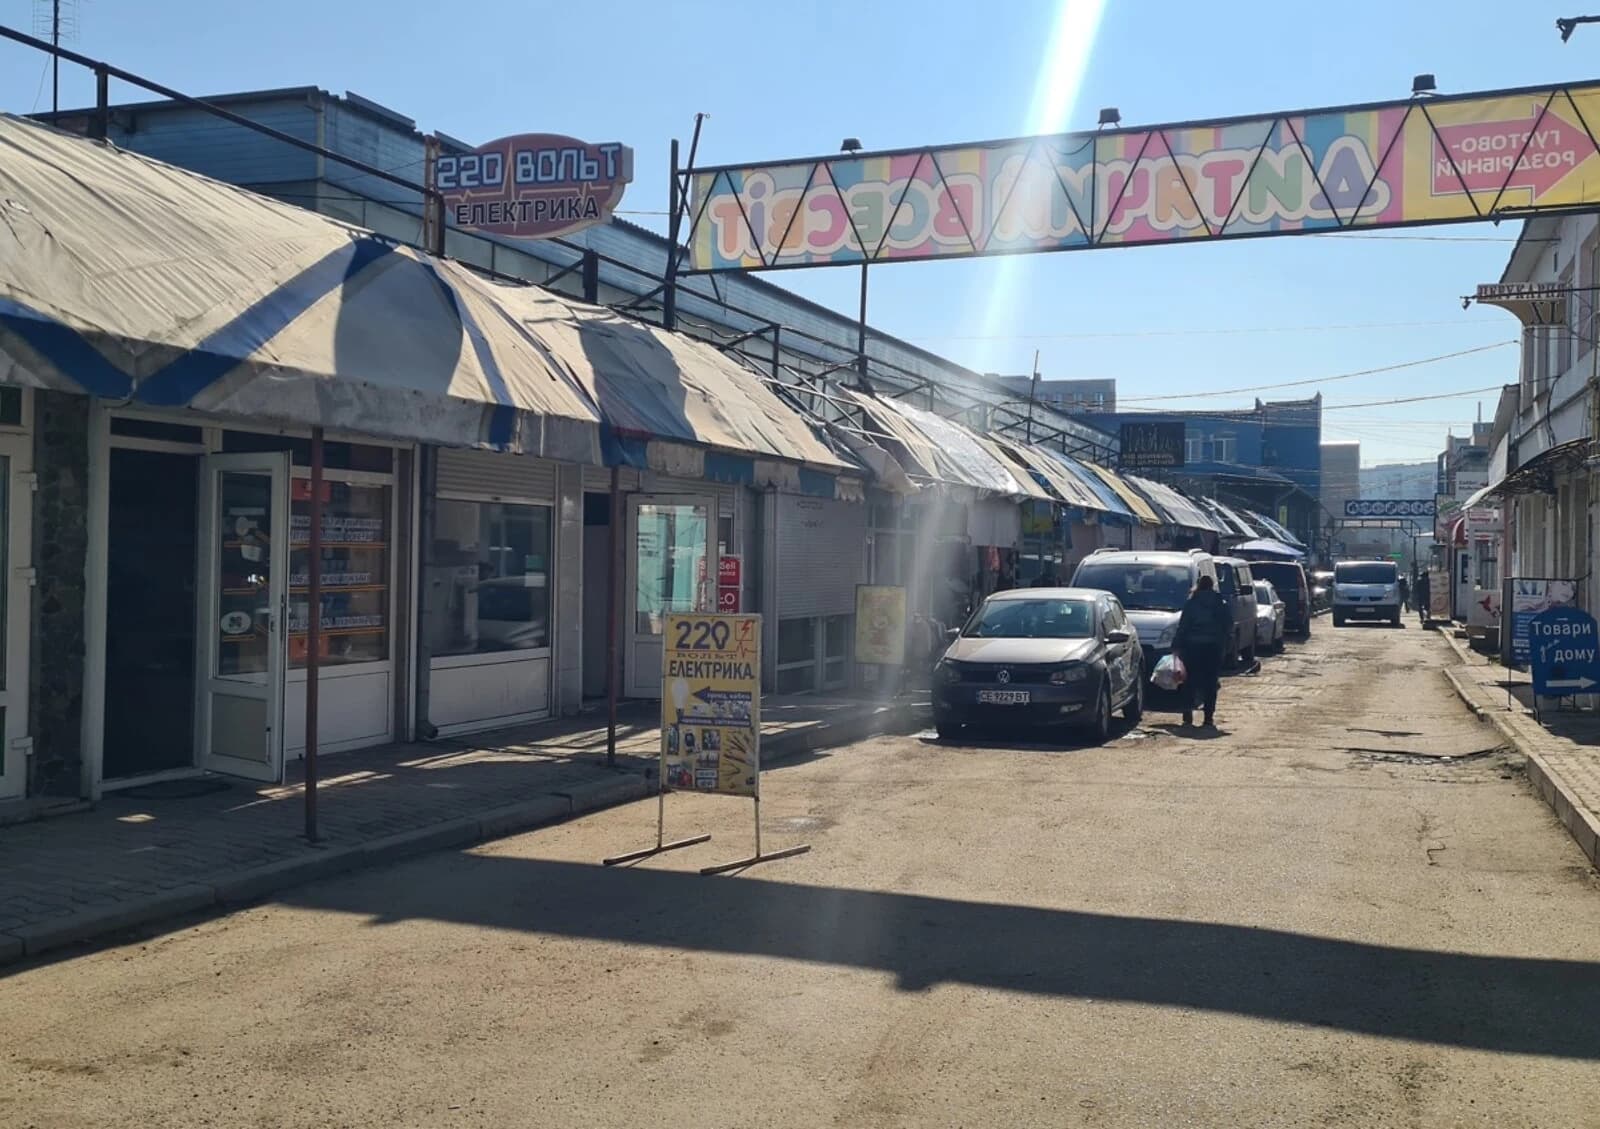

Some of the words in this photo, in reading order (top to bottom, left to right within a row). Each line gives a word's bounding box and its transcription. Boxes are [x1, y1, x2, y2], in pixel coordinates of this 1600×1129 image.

[437, 152, 503, 189] 220
[515, 143, 622, 184] ВОЛЬТ
[455, 196, 600, 226] ЕЛЕКТРИКА
[675, 620, 730, 650] 220
[1532, 621, 1592, 638] Товари
[1554, 649, 1595, 663] дому
[669, 660, 754, 680] ЕЛЕКТРИКА
